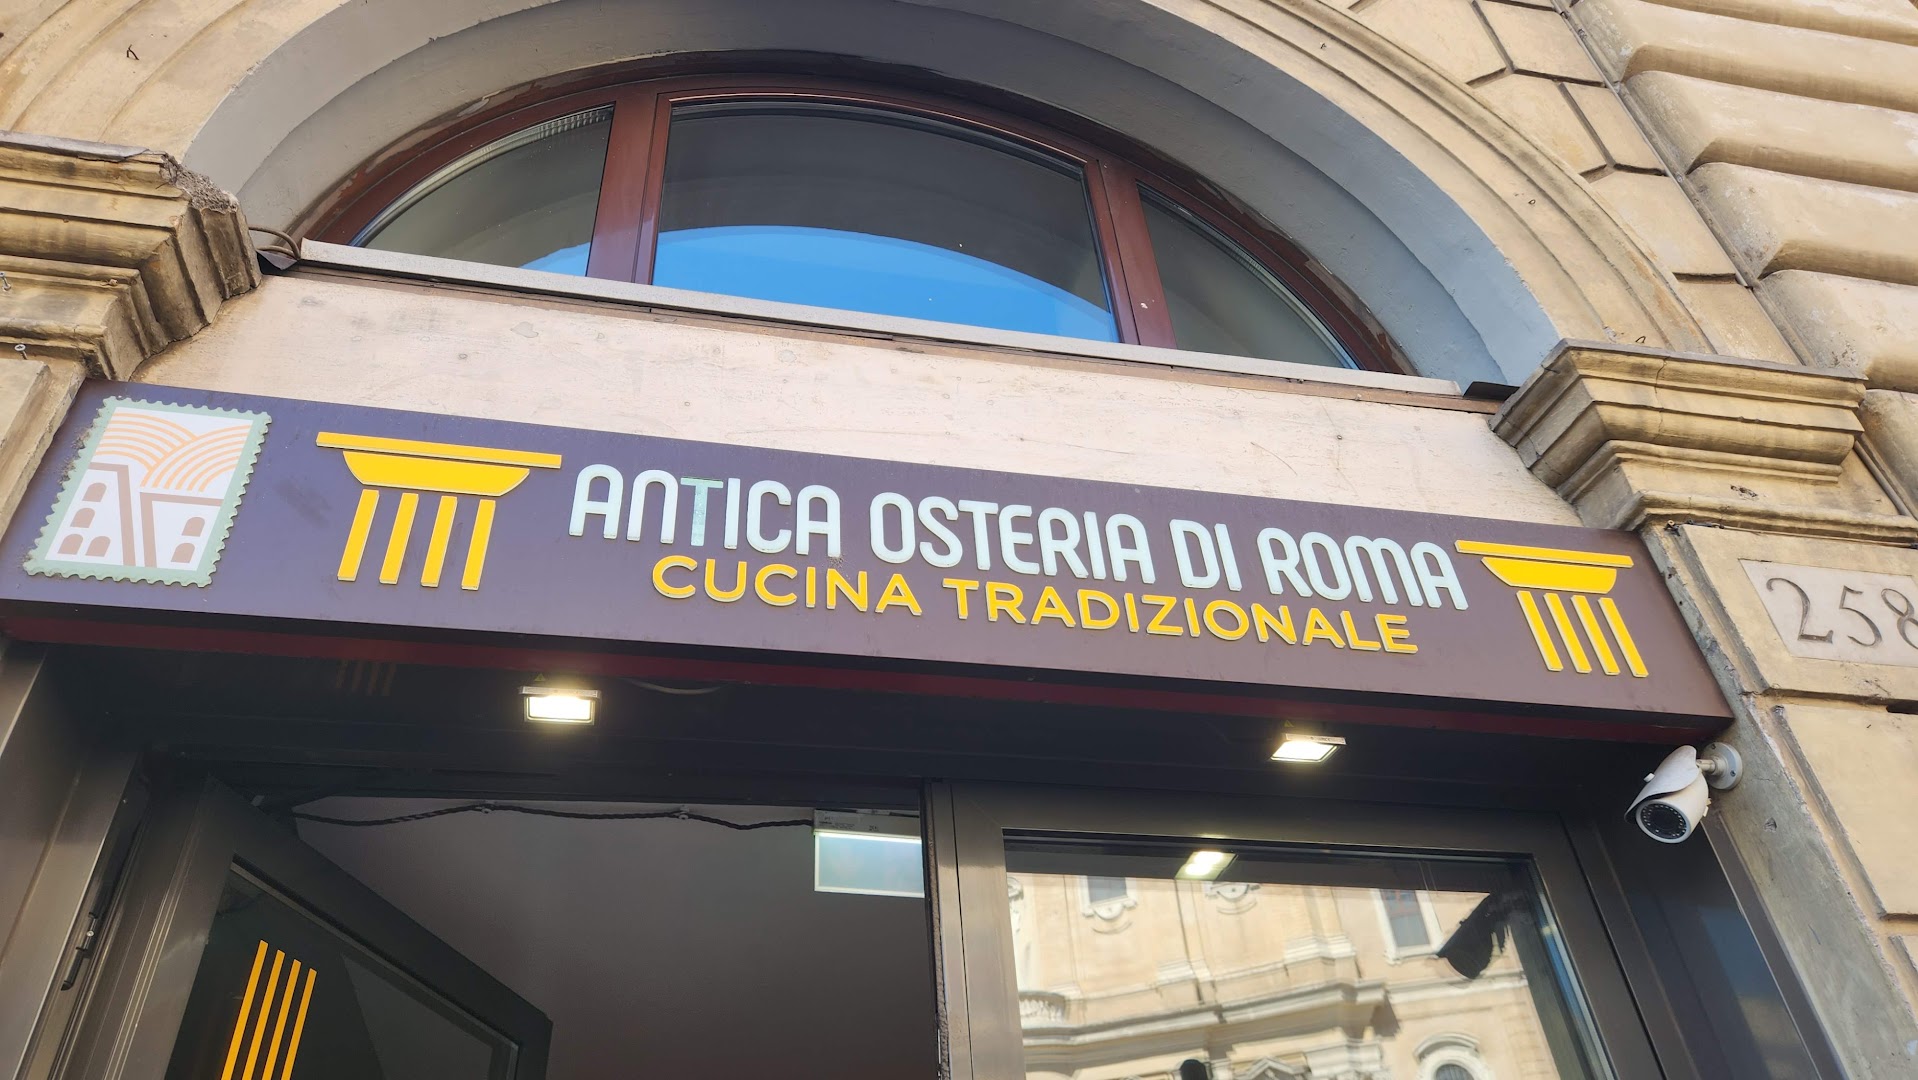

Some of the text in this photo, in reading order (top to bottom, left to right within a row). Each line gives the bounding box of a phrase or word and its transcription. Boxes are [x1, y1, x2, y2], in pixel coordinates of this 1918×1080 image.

[569, 463, 1469, 610] ANTICA OSTERIA DI ROMA
[652, 555, 1419, 654] CUCINA TRADIZIONALE
[1765, 577, 1918, 650] 258
